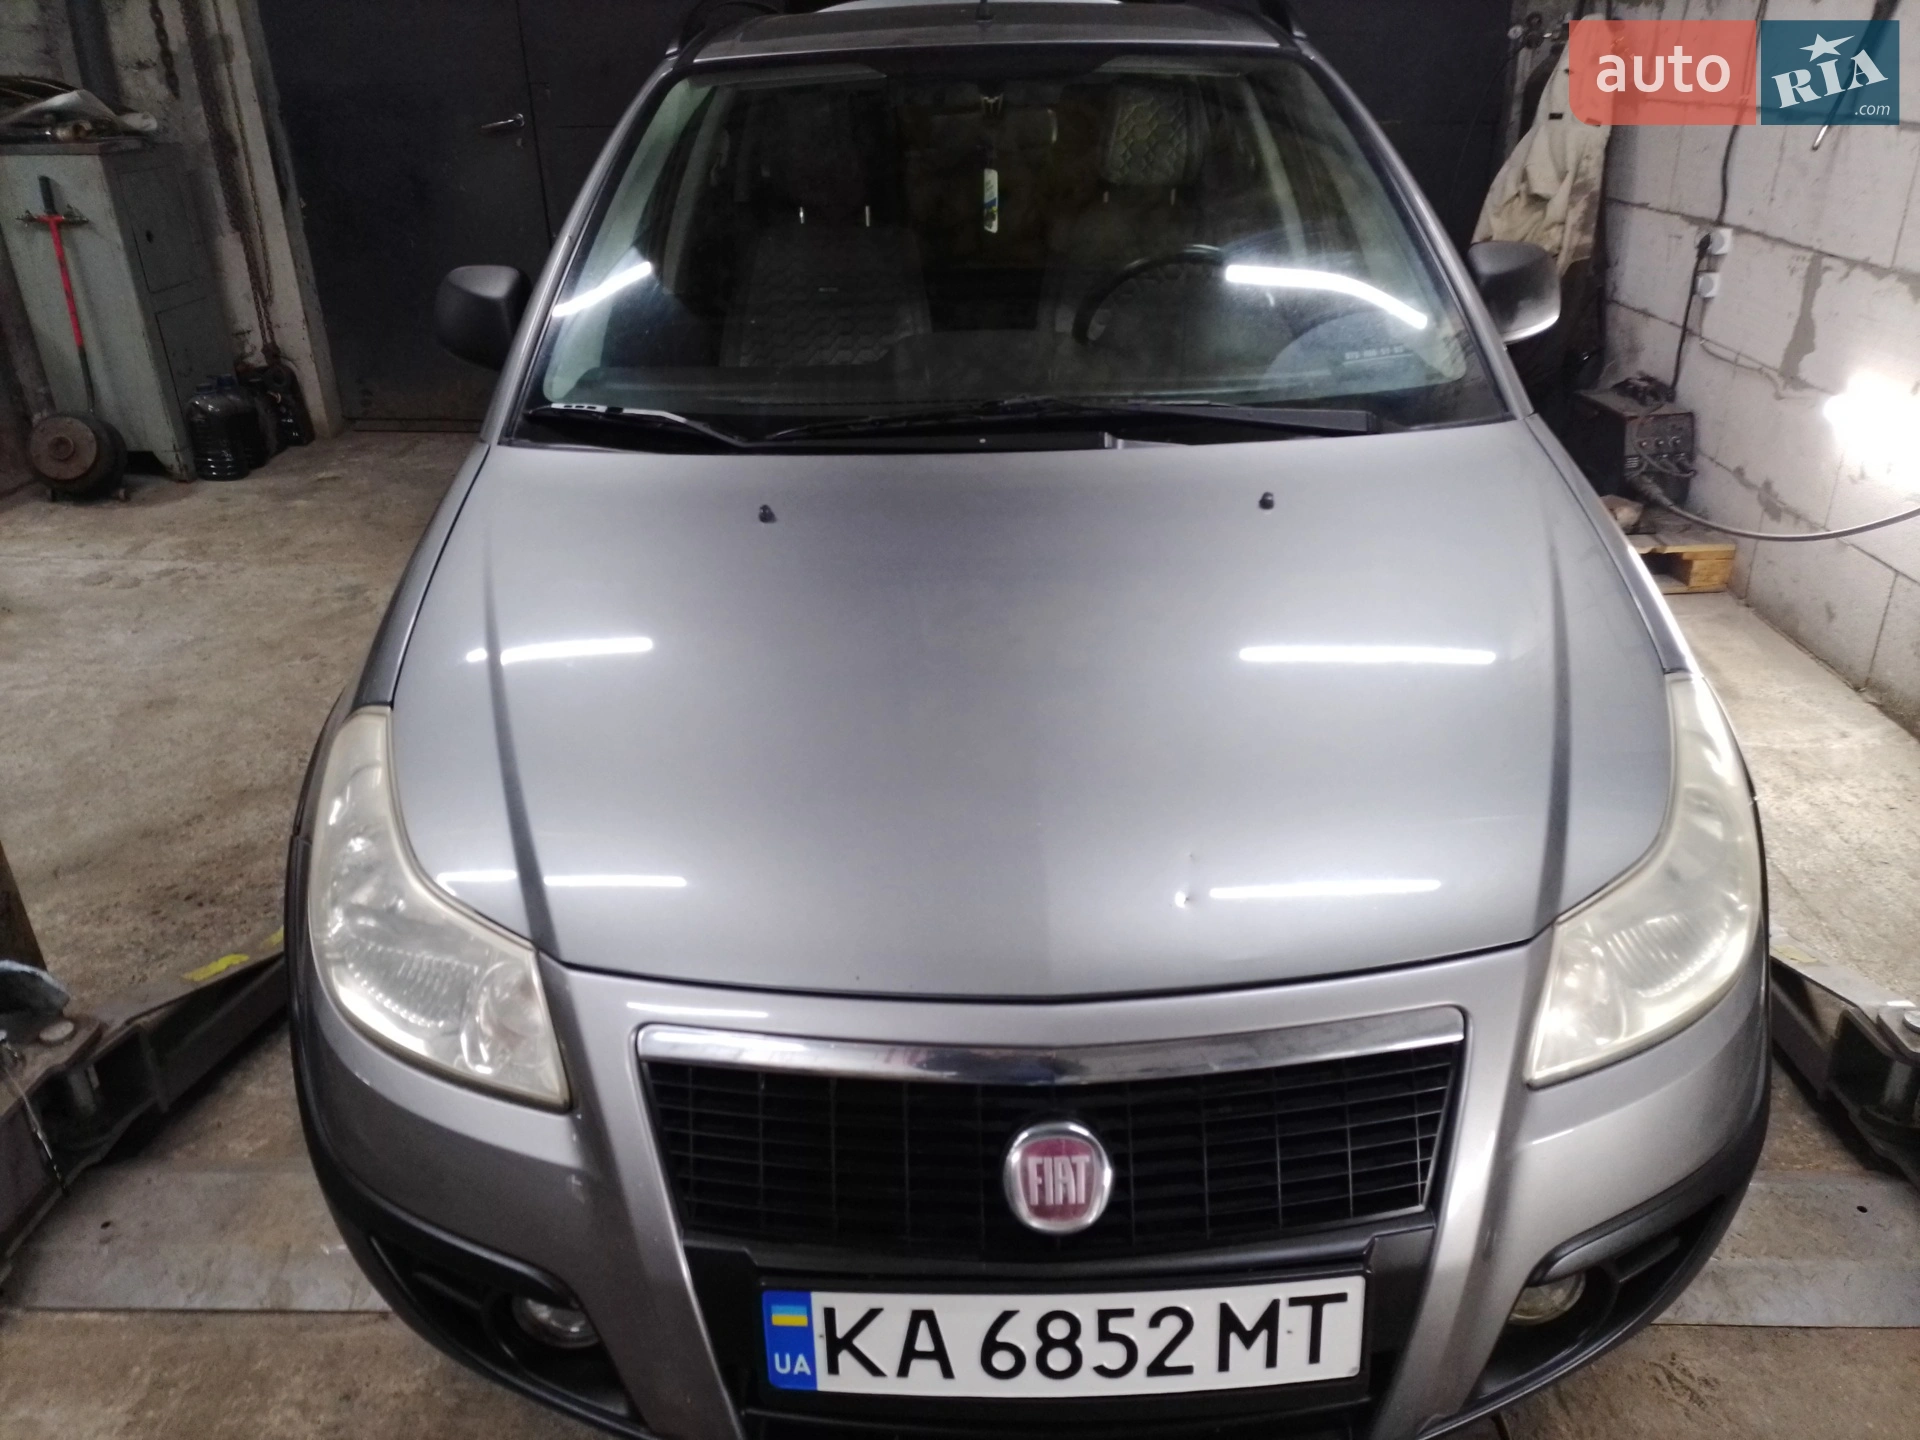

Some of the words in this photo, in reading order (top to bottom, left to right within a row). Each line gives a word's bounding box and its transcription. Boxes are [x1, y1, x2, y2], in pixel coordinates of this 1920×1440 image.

[1028, 1154, 1090, 1206] FIAT
[822, 1307, 956, 1379] KA
[979, 1306, 1195, 1380] 6852
[1217, 1292, 1349, 1373] MT
[774, 1353, 811, 1376] UA
